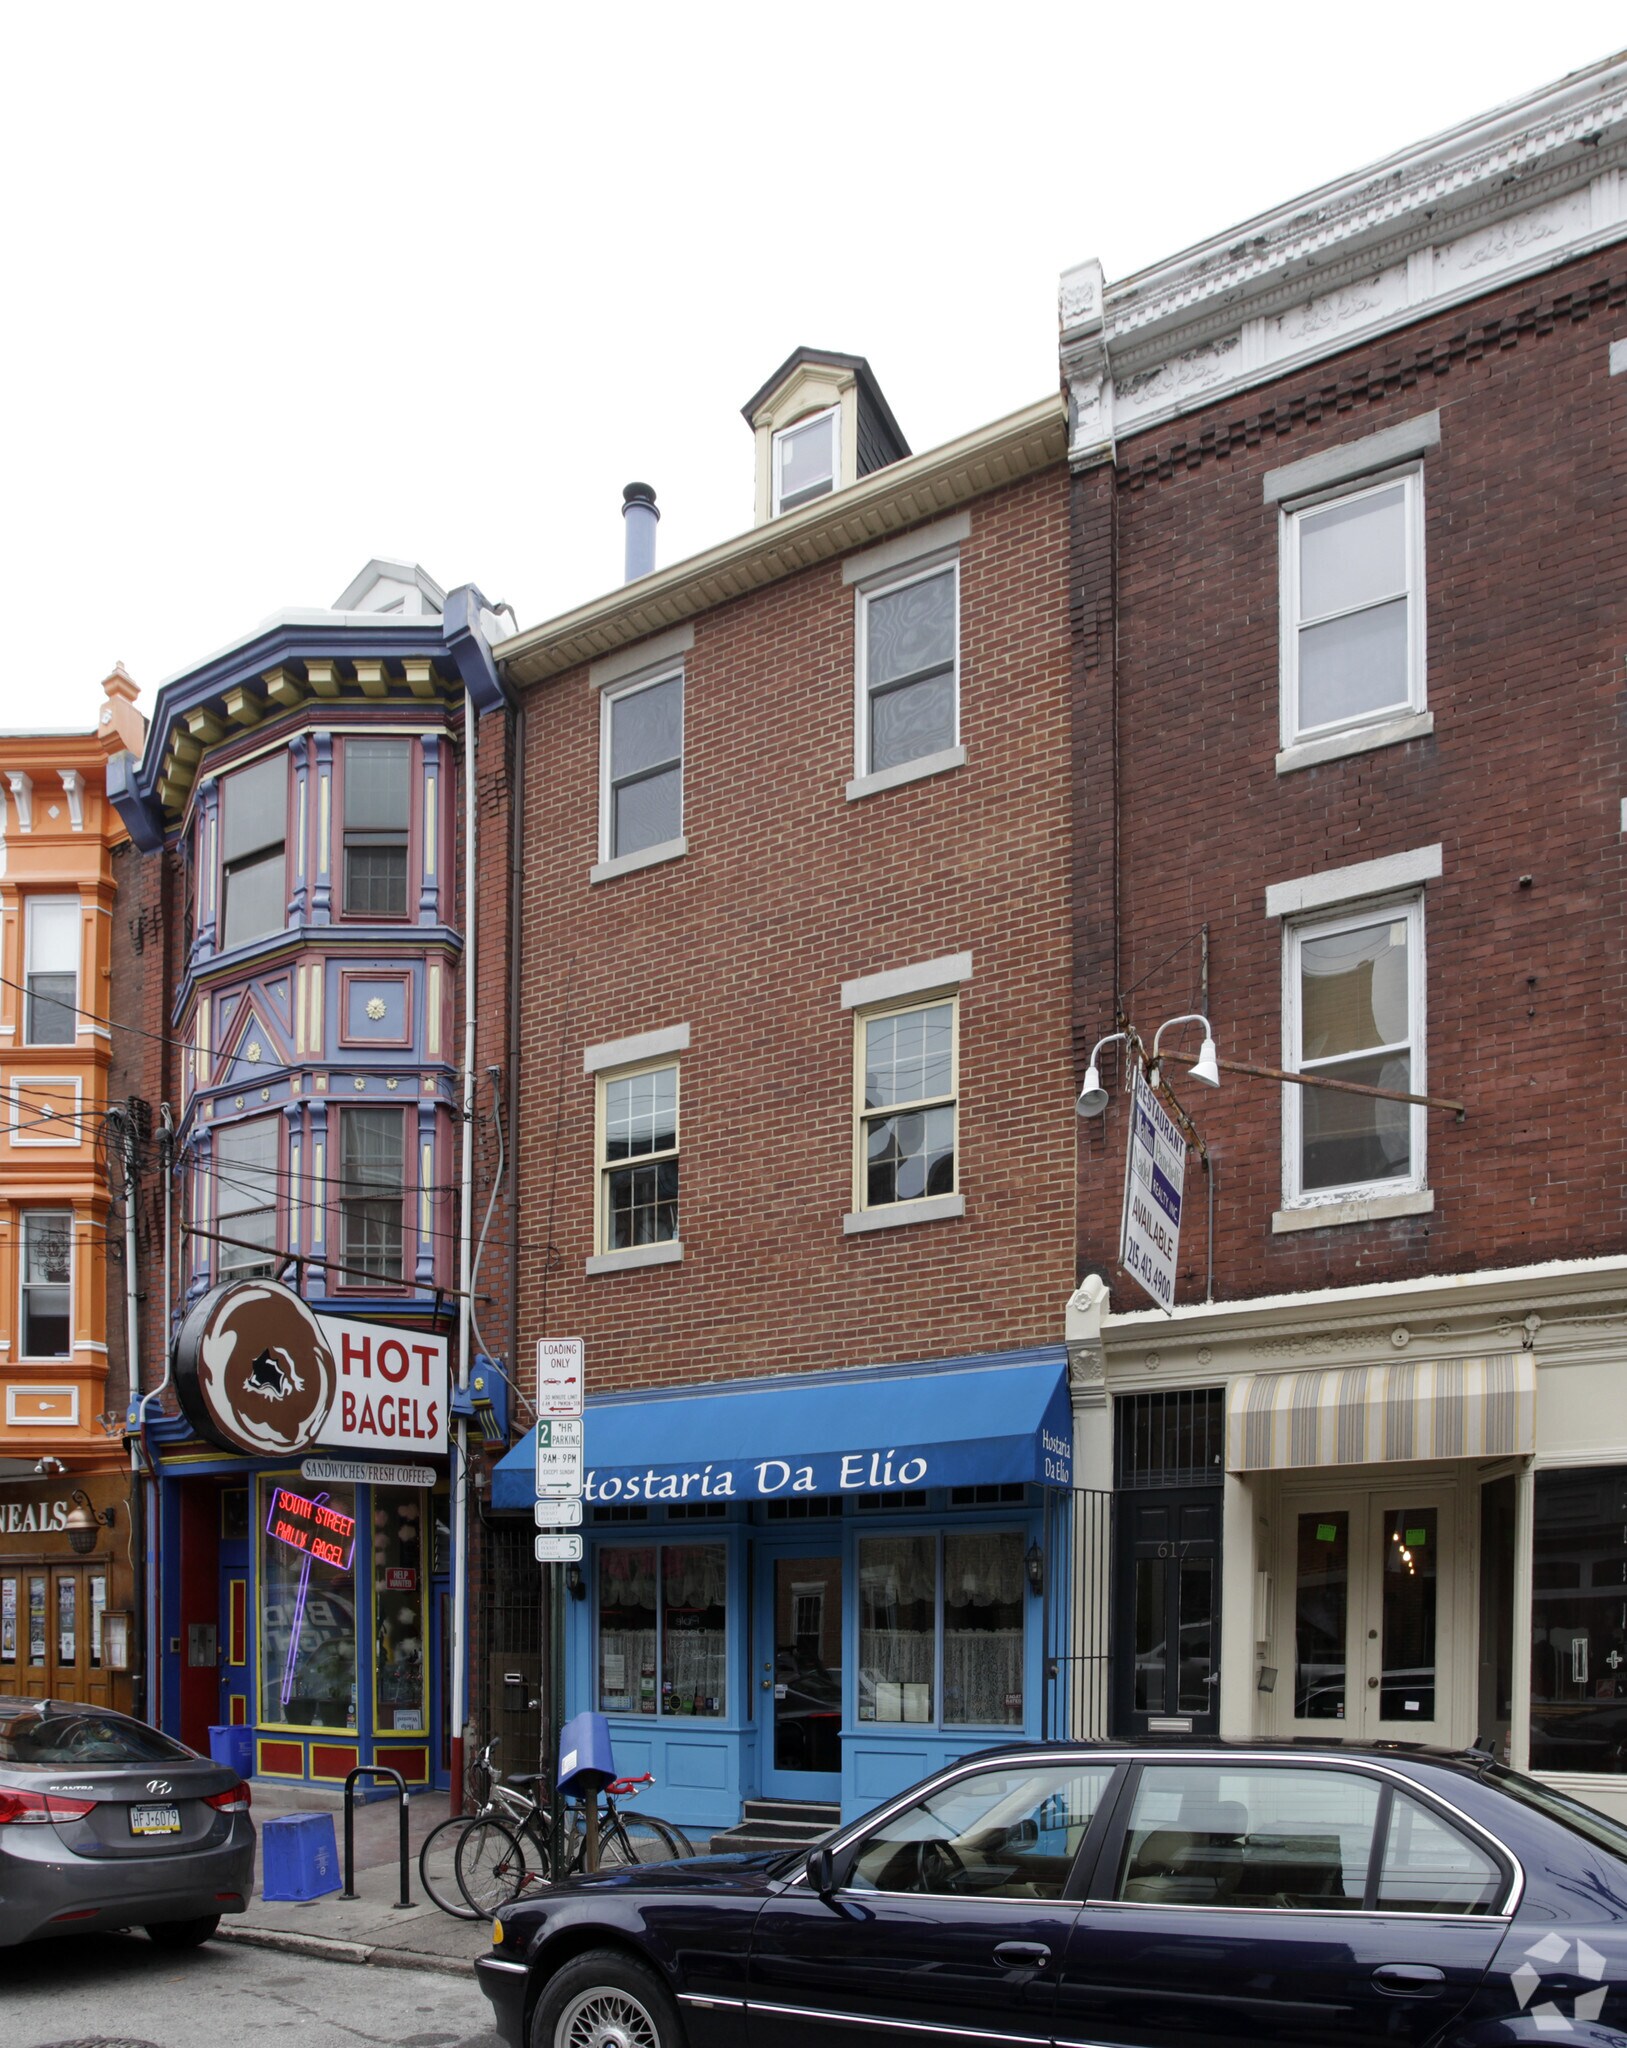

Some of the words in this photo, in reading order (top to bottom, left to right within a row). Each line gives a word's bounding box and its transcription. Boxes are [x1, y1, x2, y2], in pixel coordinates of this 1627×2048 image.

[1138, 1076, 1184, 1157] RESTAURANT
[1152, 1178, 1170, 1209] REALTY
[1131, 1194, 1173, 1263] AVAILABLE
[1126, 1235, 1171, 1304] 215.413.4900
[342, 1332, 439, 1387] HOT
[544, 1344, 577, 1355] LOADING
[551, 1358, 570, 1368] ONLY
[342, 1391, 439, 1440] BAGELS
[540, 1424, 549, 1445] 2
[561, 1423, 573, 1433] HR
[552, 1434, 580, 1445] PARKING
[1043, 1428, 1070, 1459] Hostaria
[396, 1467, 427, 1484] COFFEE
[754, 1460, 818, 1493] Da
[839, 1449, 928, 1489] Elio
[1045, 1457, 1055, 1479] Da
[1056, 1459, 1069, 1483] Elio
[278, 1491, 313, 1519] SOUTH
[315, 1507, 356, 1537] STREET
[567, 1503, 576, 1522] 7
[275, 1520, 309, 1549] PHILLY
[311, 1537, 344, 1568] BAGEL
[568, 1540, 577, 1557] 5
[1157, 1541, 1190, 1558] 617
[389, 1579, 413, 1588] WANTED
[393, 1570, 408, 1579] HELP
